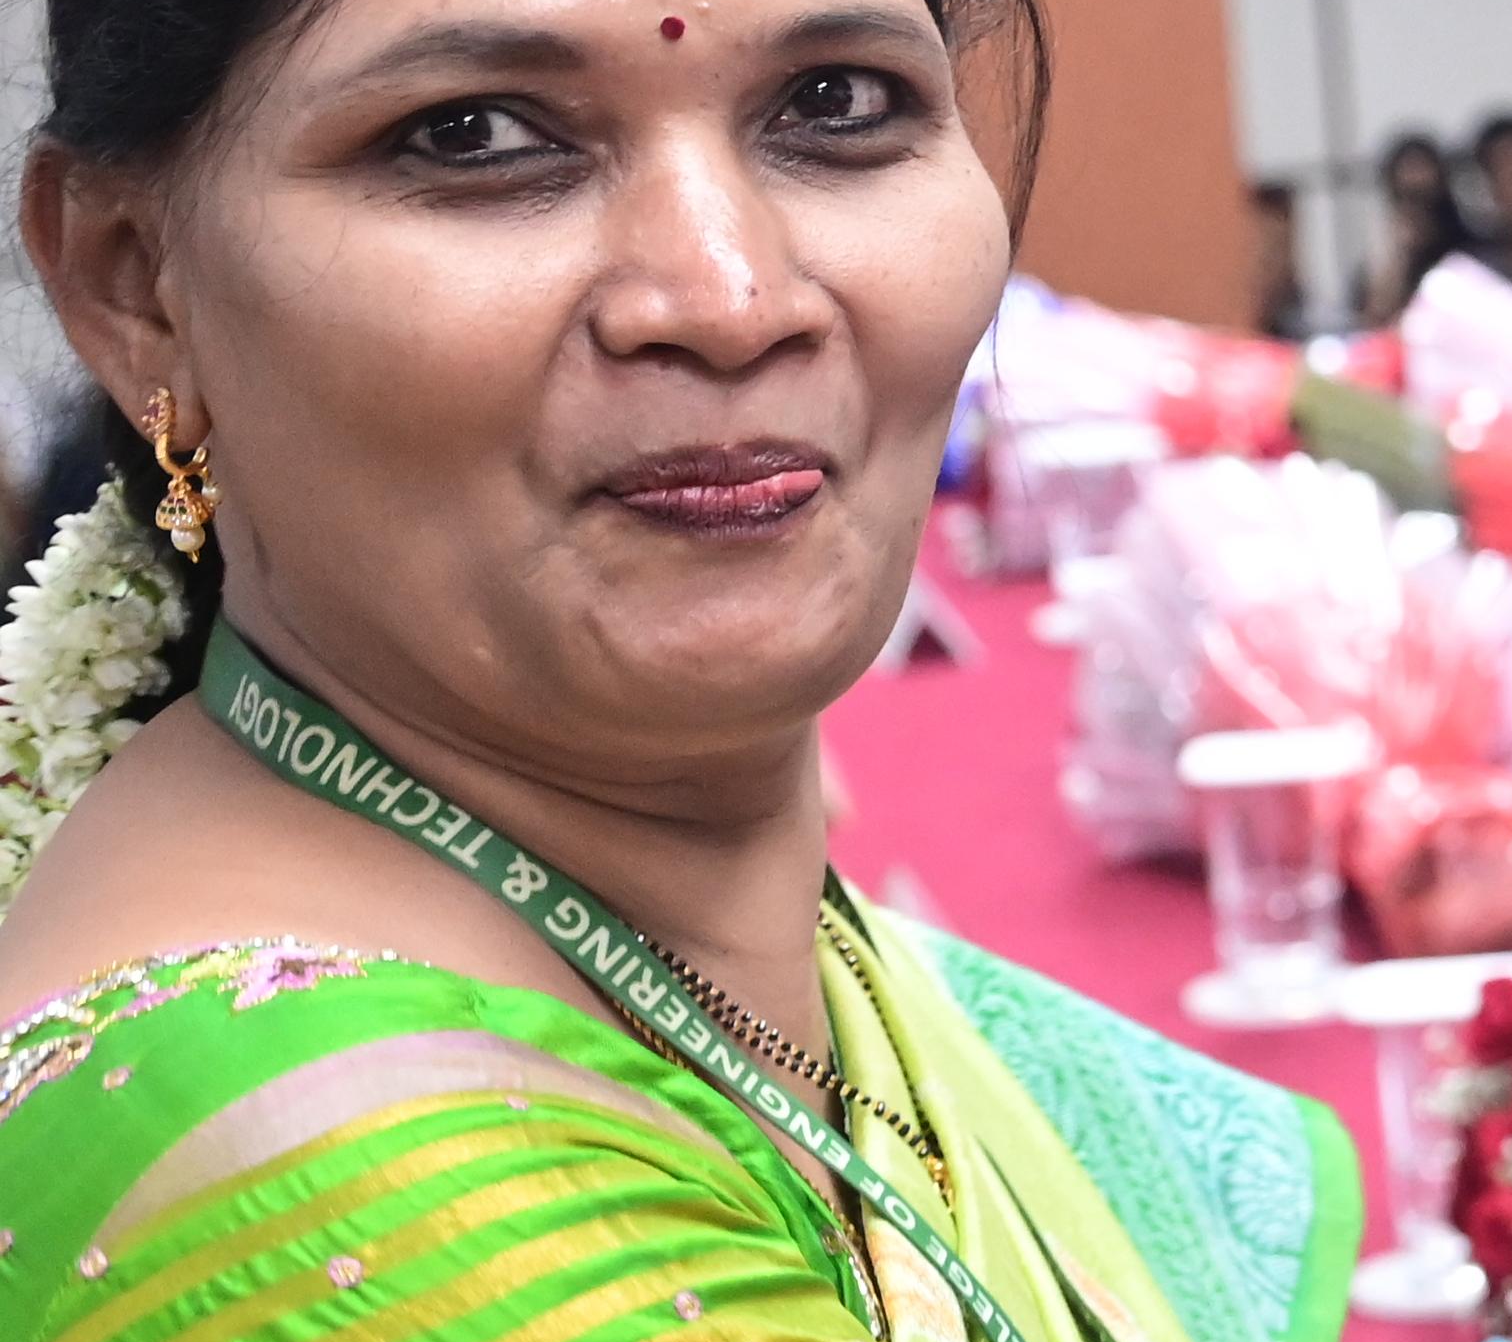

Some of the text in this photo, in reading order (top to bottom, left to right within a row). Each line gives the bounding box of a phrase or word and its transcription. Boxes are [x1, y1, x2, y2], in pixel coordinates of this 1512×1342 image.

[228, 672, 495, 870] TECHNOLOGY
[501, 851, 549, 898] &
[544, 896, 852, 1171] ENGINEERING
[859, 1176, 917, 1231] OF
